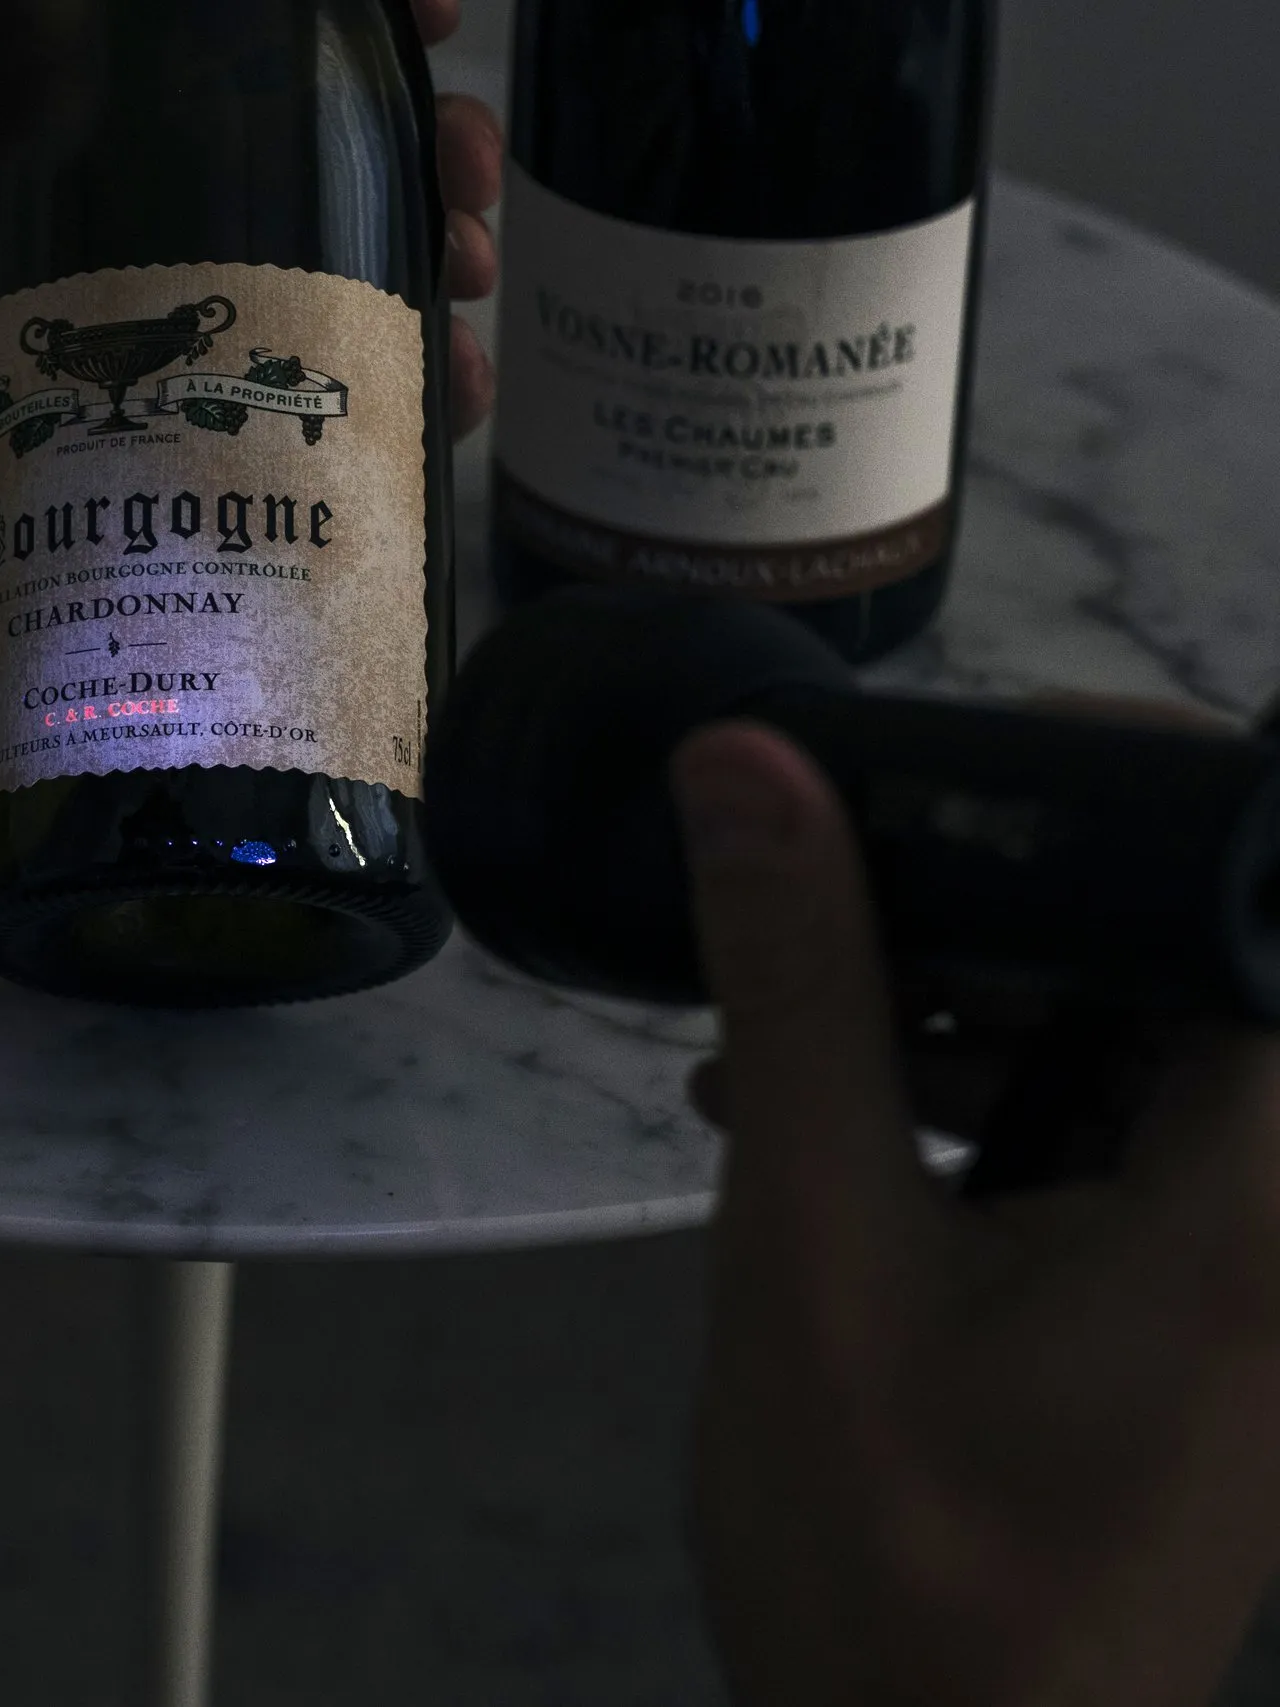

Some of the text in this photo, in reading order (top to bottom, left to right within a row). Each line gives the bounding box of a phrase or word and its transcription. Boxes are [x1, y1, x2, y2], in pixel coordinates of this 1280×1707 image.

[537, 289, 916, 380] VOSNE-ROMANÉE
[186, 378, 323, 409] À LA PROPRIÉTÉ
[592, 401, 654, 437] LES
[56, 433, 181, 457] PRODUIT DE FRANCE
[66, 561, 187, 585] BOURGOGNE
[192, 560, 313, 582] CONTRÔLÉE
[8, 592, 246, 638] CHARDONNAY
[23, 672, 221, 710] COCHE-DURY
[65, 708, 79, 723] &
[83, 705, 102, 720] R.
[107, 698, 181, 717] COCHE
[83, 722, 204, 744] MEURSAULT,
[211, 720, 318, 743] CÔTE-D'OR
